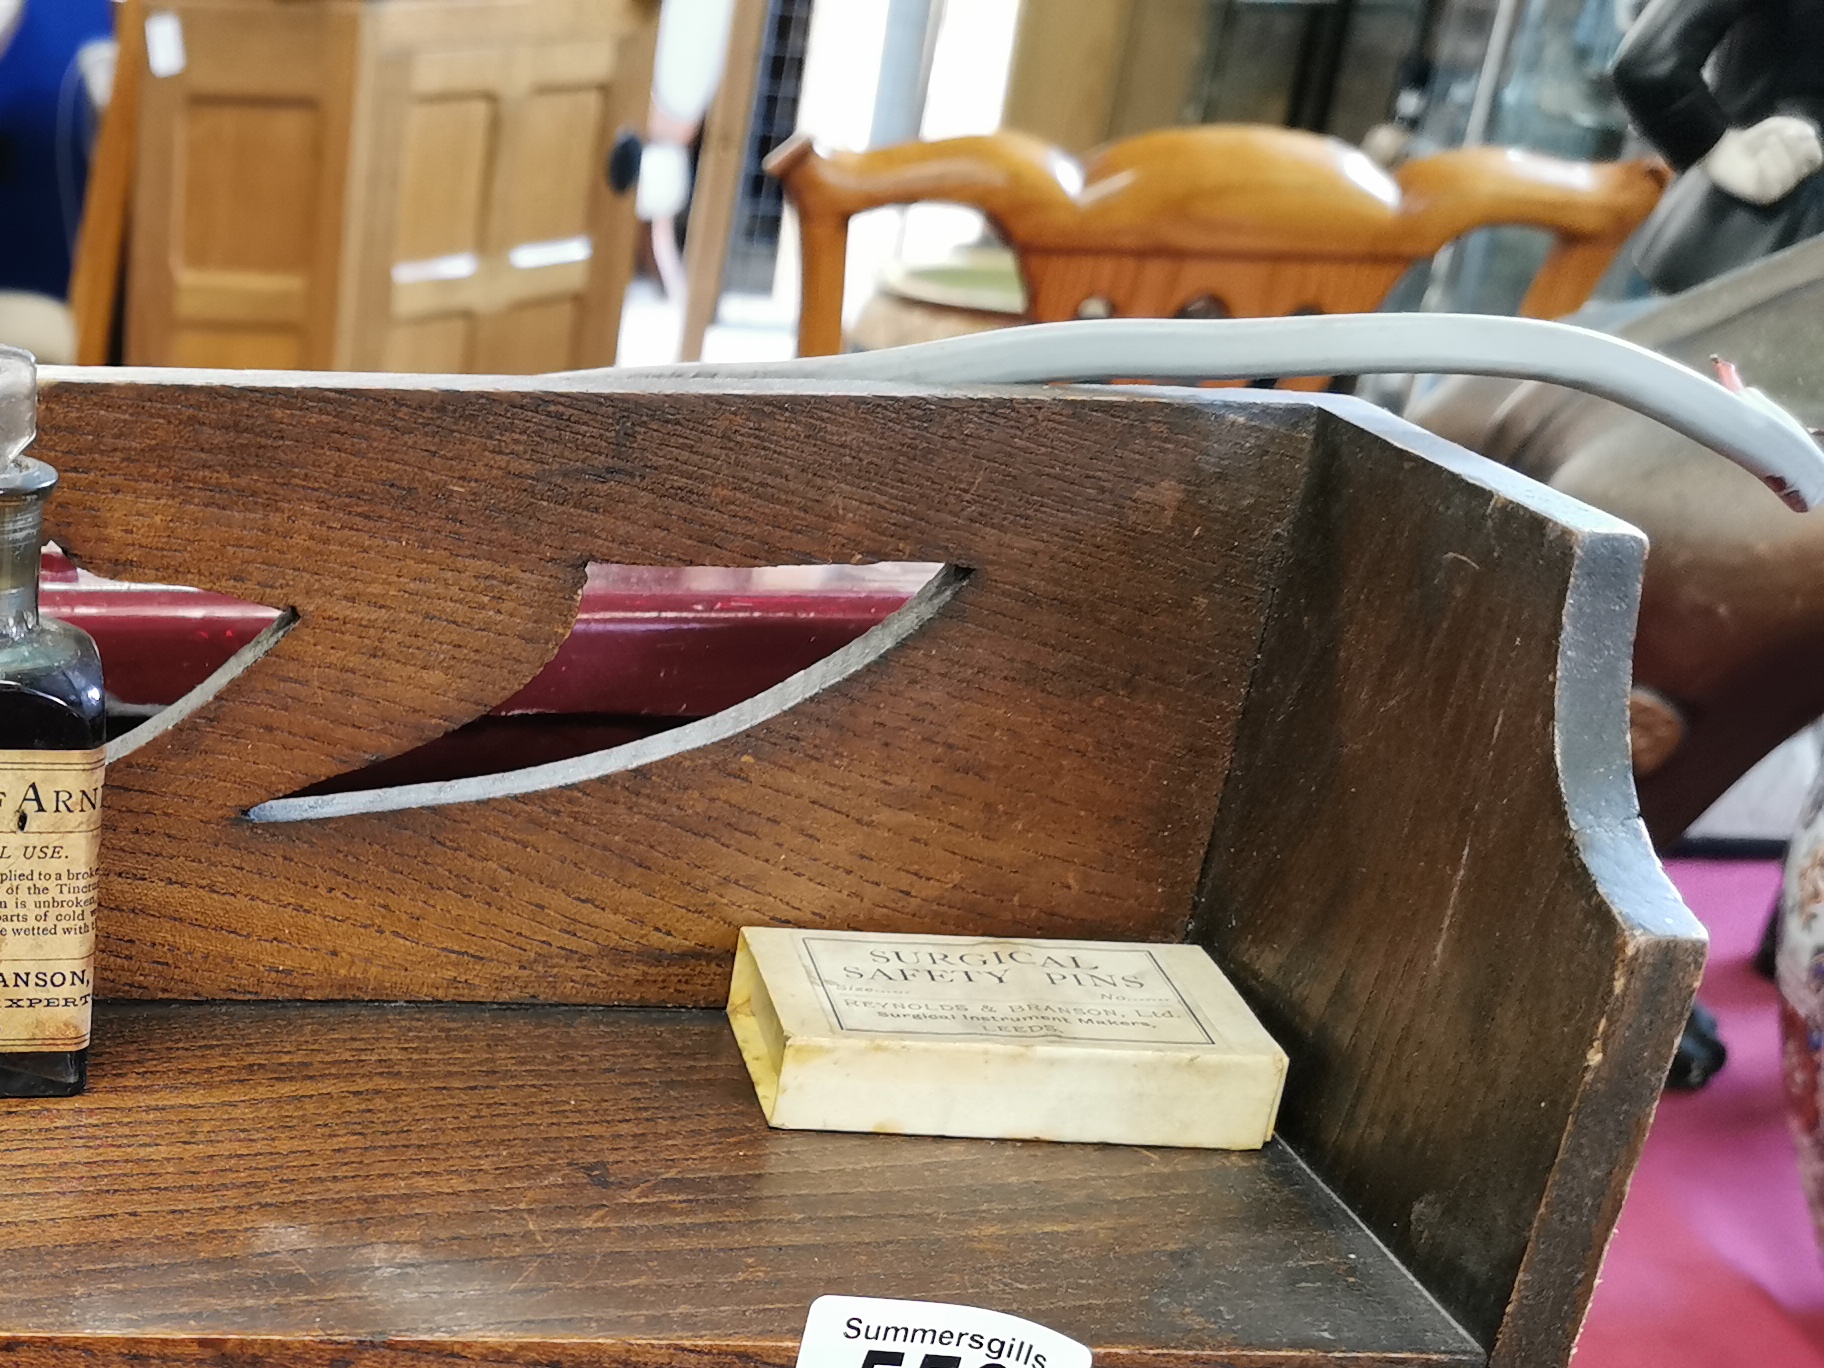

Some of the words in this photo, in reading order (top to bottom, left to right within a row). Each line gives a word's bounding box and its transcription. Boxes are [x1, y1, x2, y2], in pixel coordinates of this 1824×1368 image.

[23, 844, 69, 860] USE.
[38, 869, 52, 881] to
[55, 872, 62, 881] a
[6, 884, 20, 895] of
[27, 884, 49, 895] the
[15, 897, 26, 909] is
[35, 910, 49, 922] of
[56, 909, 85, 922] cold
[12, 924, 57, 937] wetted
[62, 922, 89, 935] with
[869, 949, 1099, 969] SURGICAL
[843, 966, 1010, 984] SAFETY
[1045, 972, 1145, 989] PINS
[844, 998, 968, 1012] REYNOLDS
[981, 1004, 996, 1013] &
[1008, 1003, 1126, 1018] BRANSON,
[1135, 1009, 1181, 1019] Ltd.
[877, 1010, 956, 1021] Surgical
[963, 1013, 1073, 1024] Instrument
[982, 1024, 1064, 1034] LEEDS.
